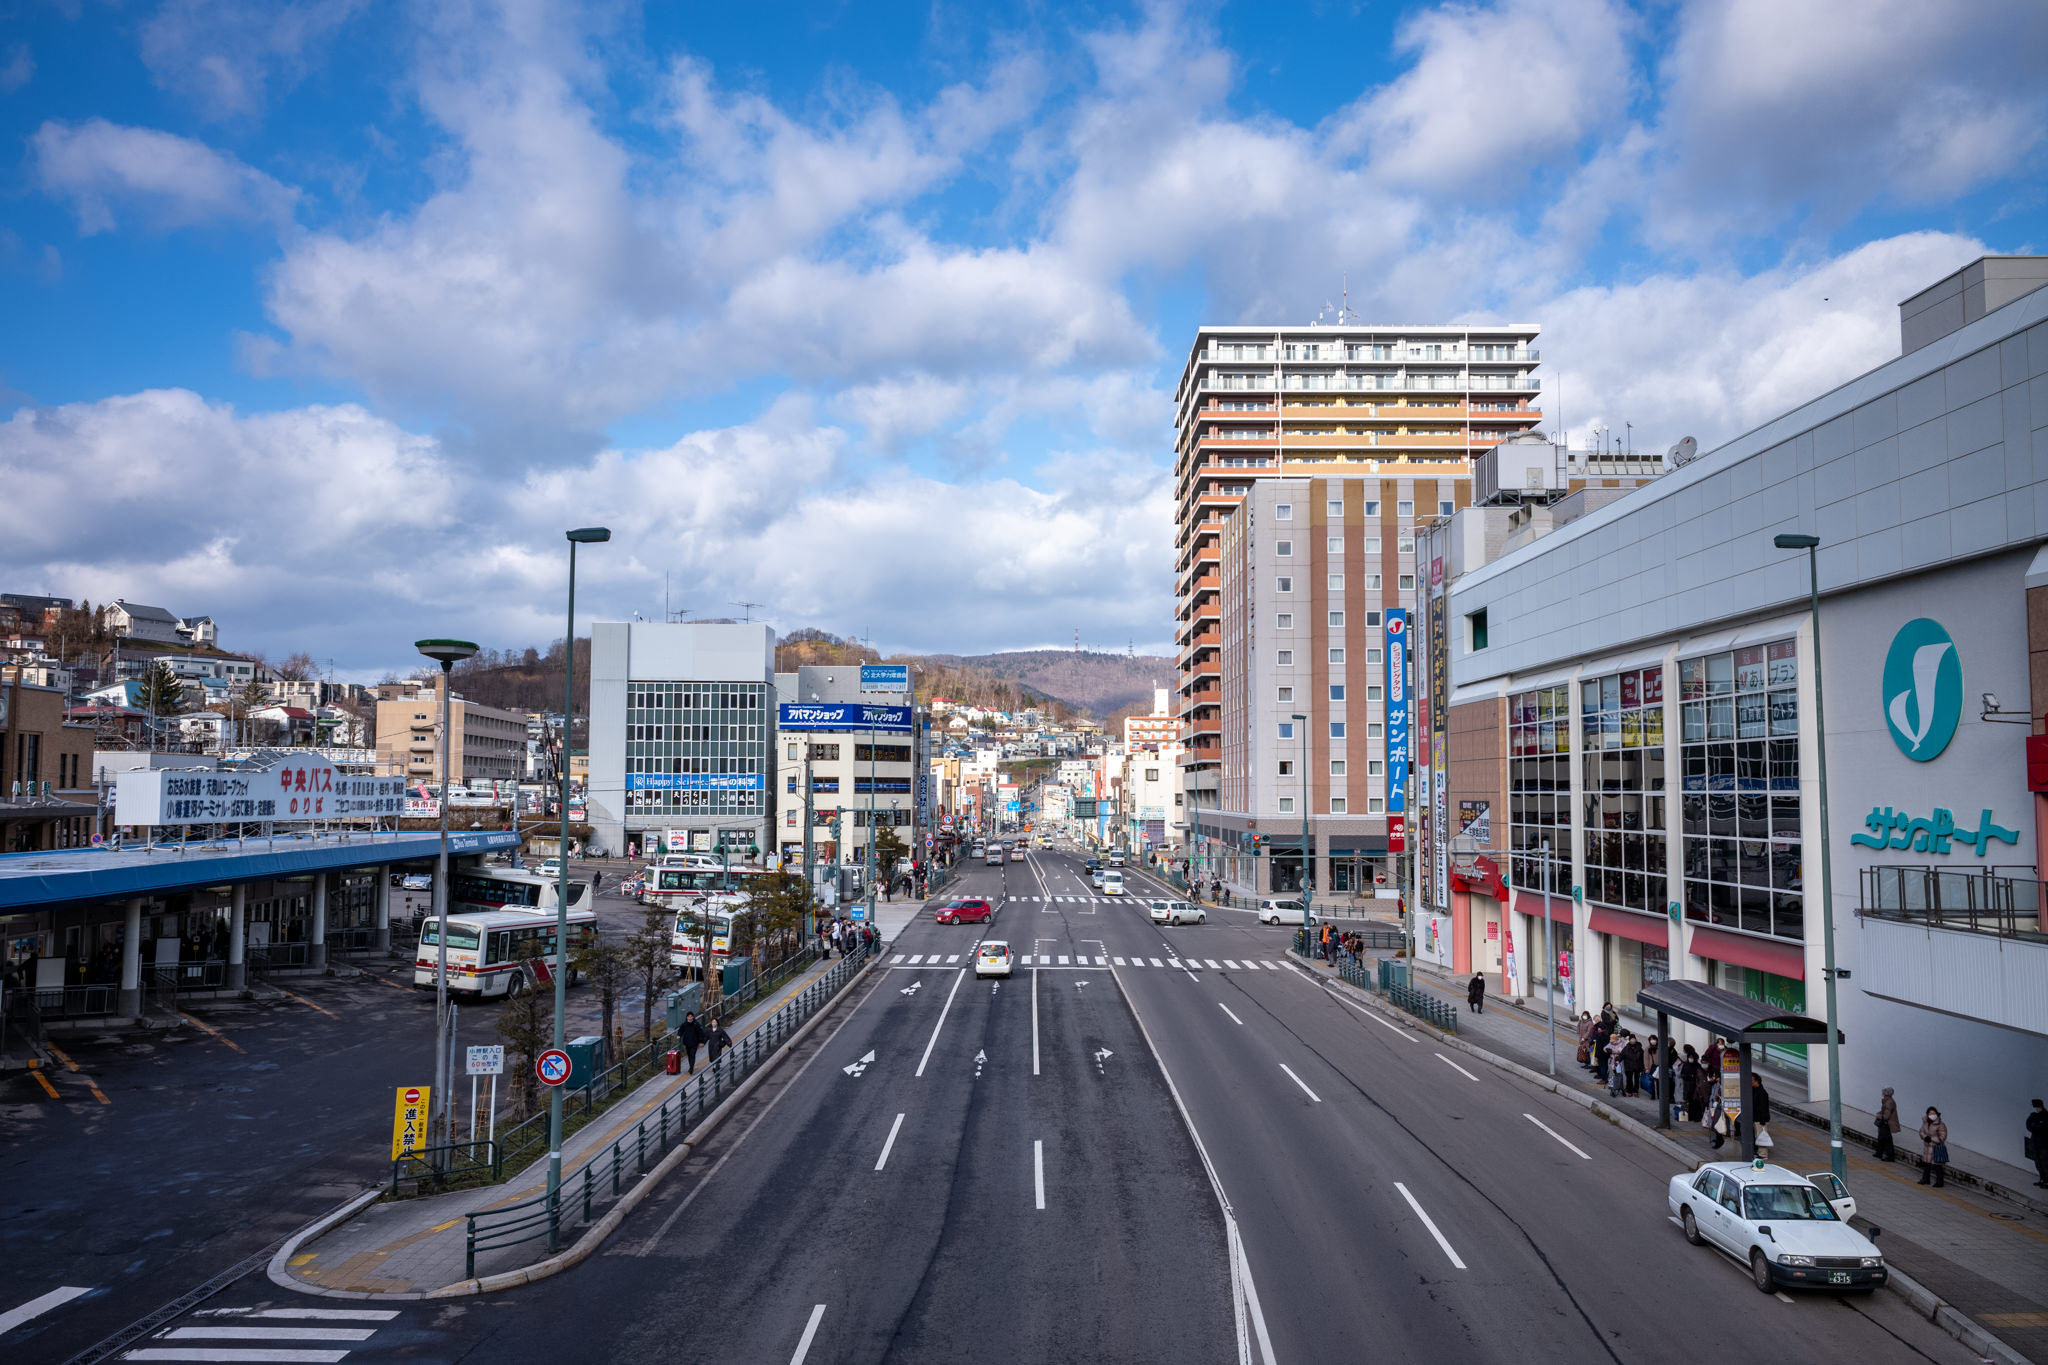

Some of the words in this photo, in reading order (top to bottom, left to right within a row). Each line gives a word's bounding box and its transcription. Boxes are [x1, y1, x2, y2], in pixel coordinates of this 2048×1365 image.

[1392, 646, 1401, 698] ショッピングタウン
[788, 709, 844, 720] アパマンショップ
[1390, 709, 1406, 799] サンポート
[280, 766, 332, 792] 中央バス
[646, 777, 671, 786] Happy
[675, 777, 709, 786] Science
[710, 777, 756, 786] 幸福の科学
[290, 796, 324, 814] のりば
[1850, 806, 2020, 856] サンポート
[1749, 990, 1786, 1011] DISO
[402, 1108, 418, 1157] 進入禁止
